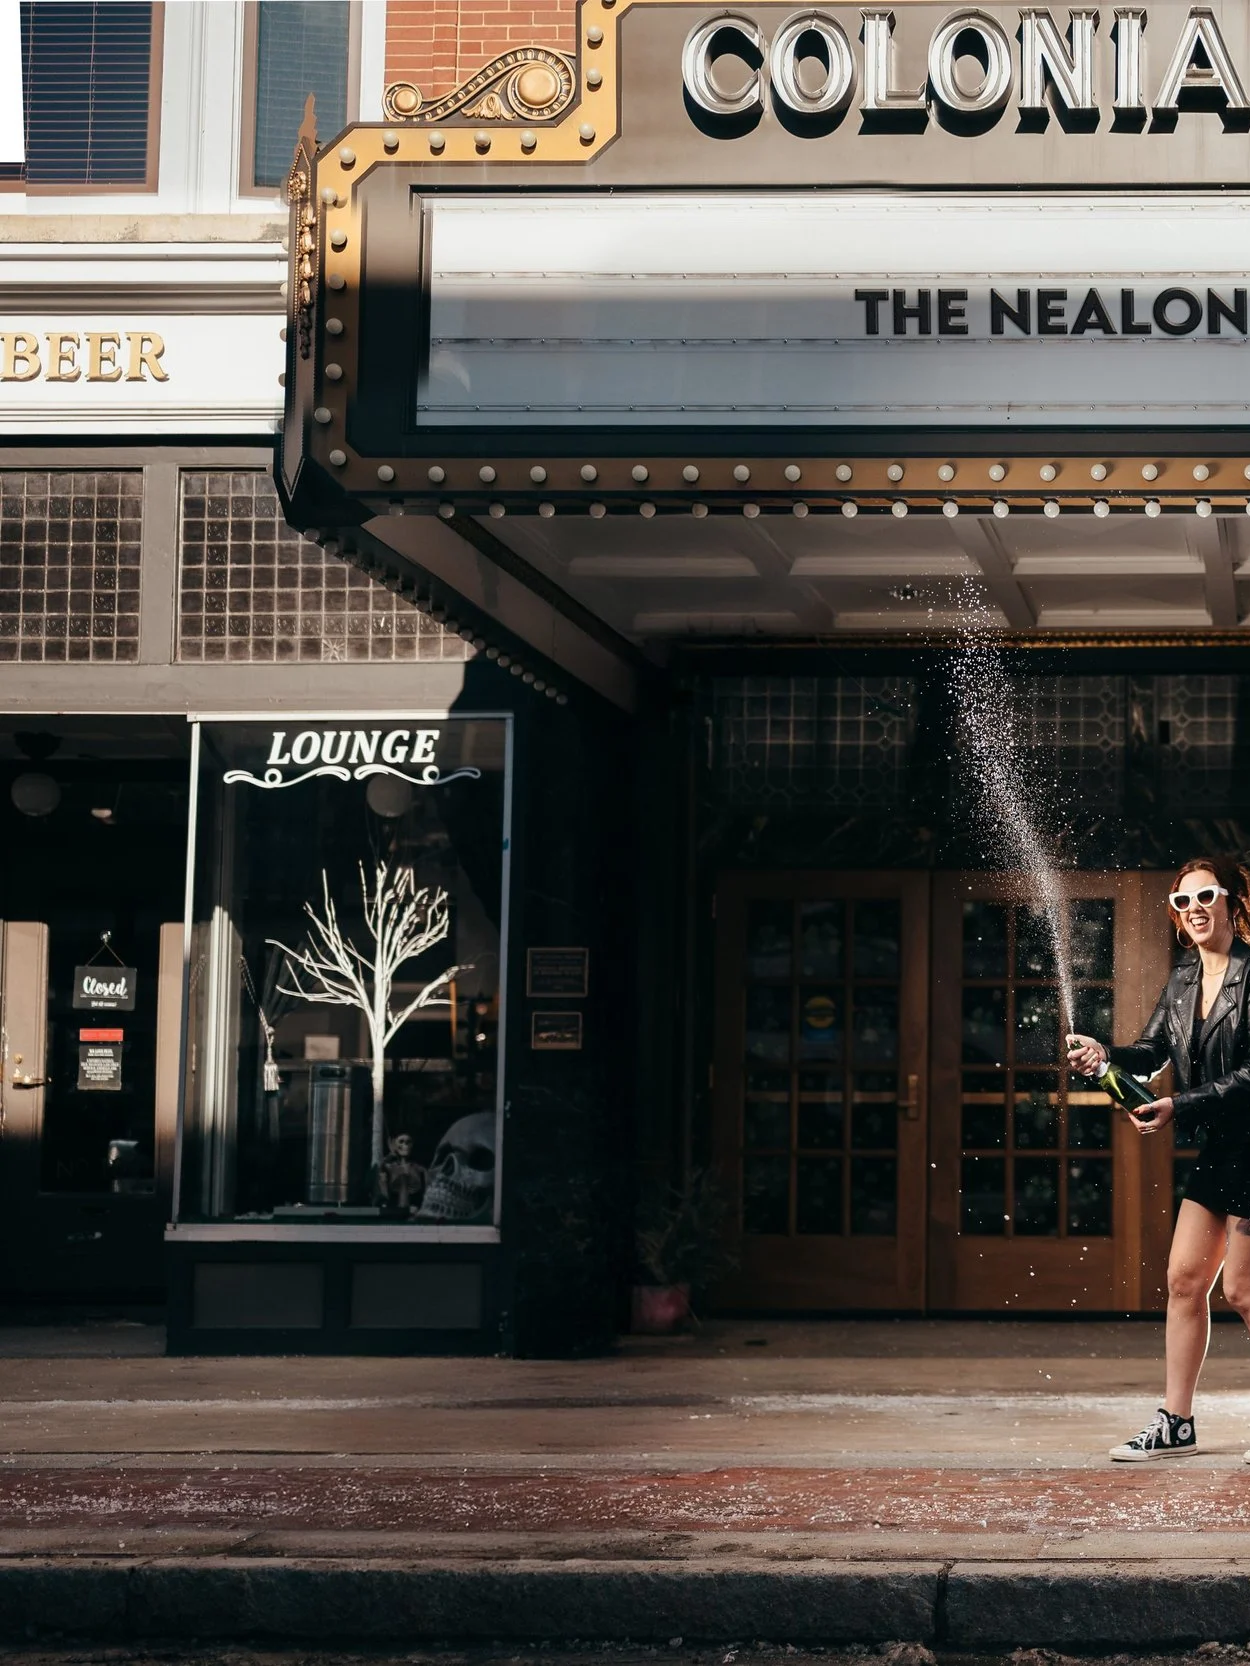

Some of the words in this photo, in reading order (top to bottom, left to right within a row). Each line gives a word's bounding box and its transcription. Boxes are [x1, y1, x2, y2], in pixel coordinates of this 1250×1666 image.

[854, 287, 969, 336] THE
[0, 332, 170, 382] BEER
[266, 729, 441, 765] LOUNGE
[82, 975, 128, 996] Closed
